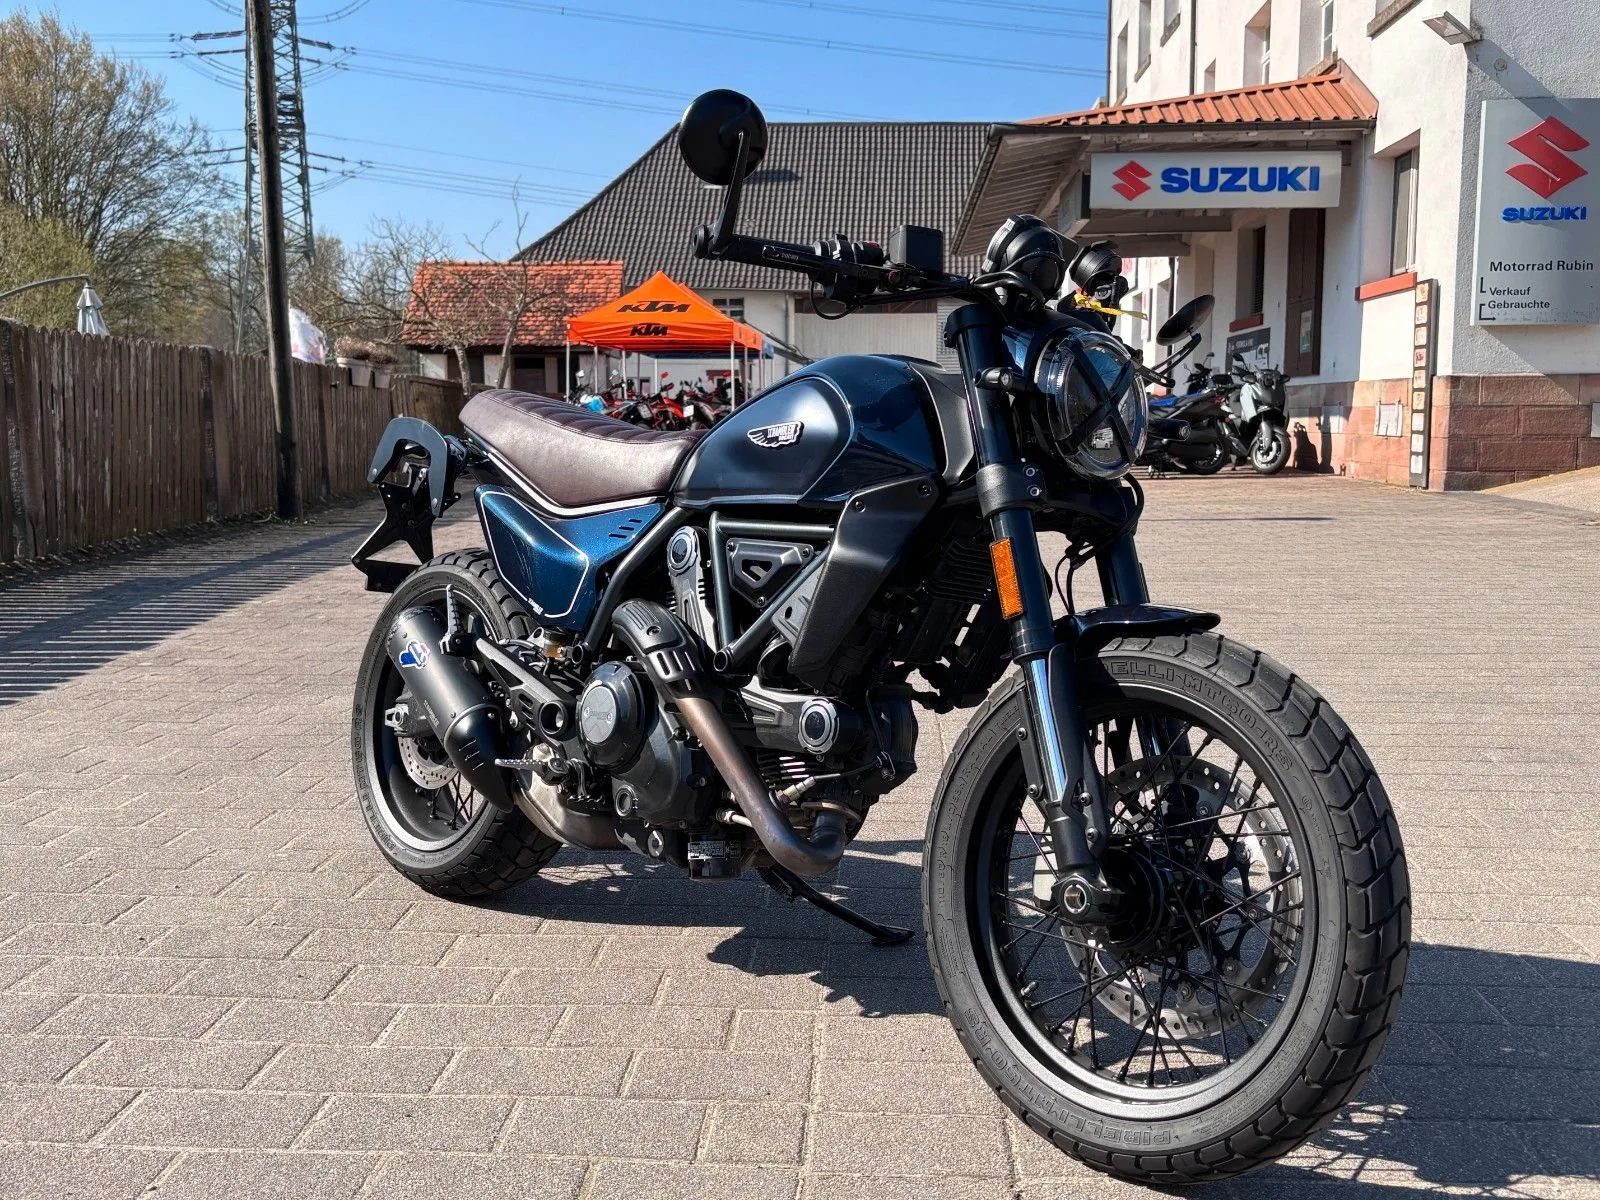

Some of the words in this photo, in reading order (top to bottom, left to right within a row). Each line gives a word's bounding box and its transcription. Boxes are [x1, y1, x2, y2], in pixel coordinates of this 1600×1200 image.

[1160, 166, 1320, 194] SUZUKI
[1502, 206, 1587, 223] SUZUKI
[1489, 260, 1553, 272] Motorrad
[1556, 260, 1594, 271] Rubin
[1489, 286, 1531, 296] Verkauf
[616, 300, 691, 313] KTM
[1487, 300, 1551, 309] Gebrauchte
[629, 322, 669, 337] KTM
[1057, 1108, 1172, 1146] PIRELLI
